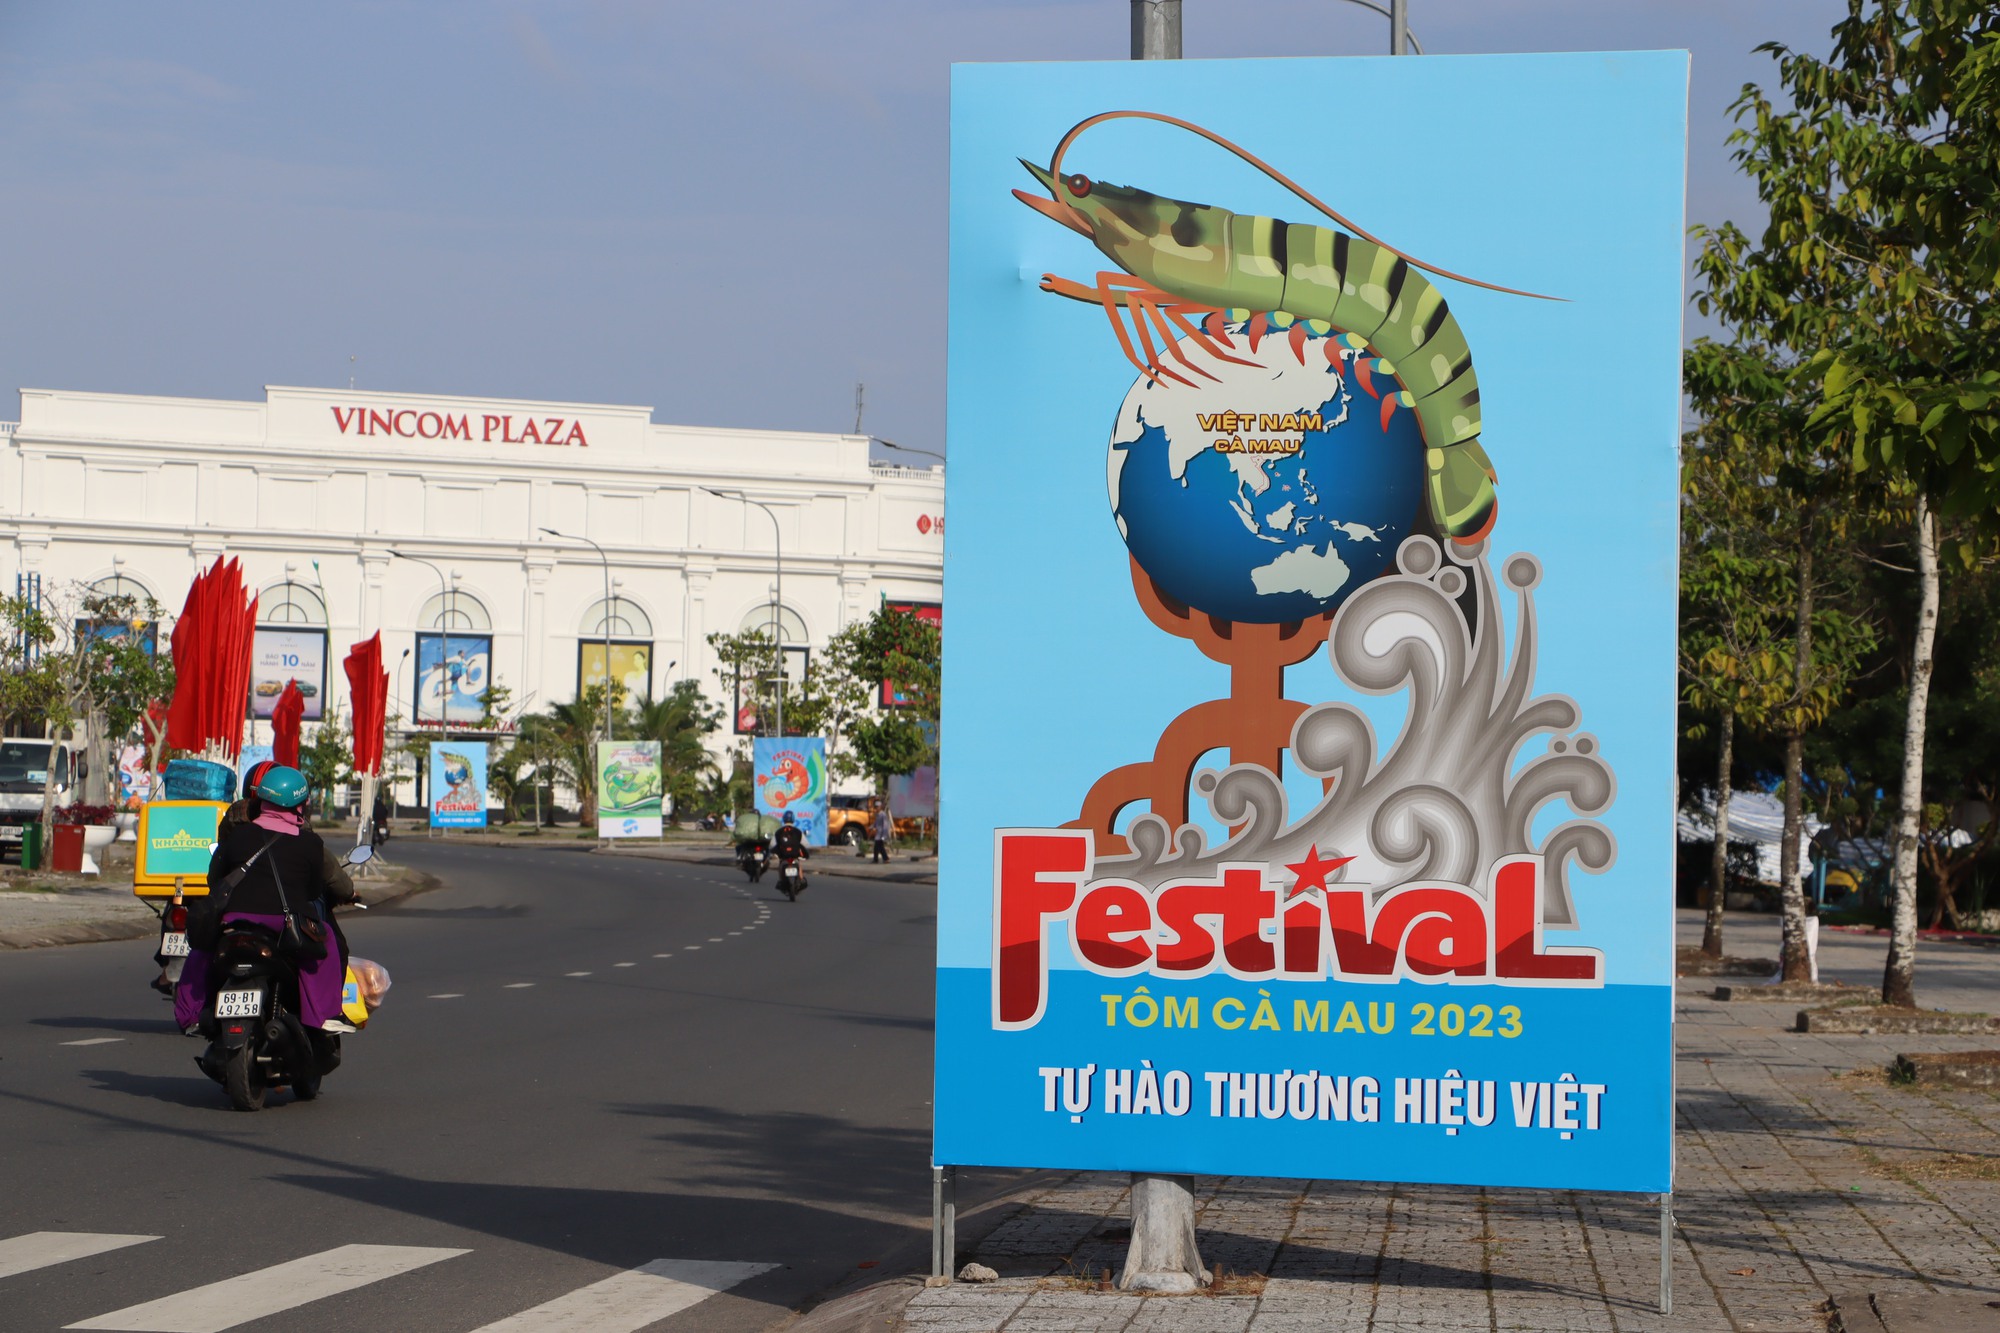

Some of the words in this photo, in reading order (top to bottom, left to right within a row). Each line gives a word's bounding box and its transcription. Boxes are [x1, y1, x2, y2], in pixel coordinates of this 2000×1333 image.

[330, 406, 473, 441] VINCOM
[482, 414, 589, 448] PLAZA
[1196, 409, 1256, 435] VIỆT
[1260, 413, 1324, 433] NAM
[1214, 435, 1247, 454] CÀ
[1248, 439, 1301, 454] MAU
[282, 654, 299, 667] 10
[155, 839, 209, 848] KHATOCO
[223, 991, 255, 1004] 69-B1
[218, 1003, 259, 1017] 492.58
[1100, 986, 1196, 1029] TÔM
[1212, 988, 1281, 1031] CÀ
[1293, 1000, 1396, 1036] MAU
[1410, 1003, 1524, 1039] 2023
[1039, 1063, 1098, 1123] TỰ
[1104, 1059, 1191, 1117] HÀO
[1205, 1069, 1380, 1124] THƯƠNG
[1394, 1068, 1496, 1136] HIỆU
[1512, 1072, 1608, 1141] VIỆT
